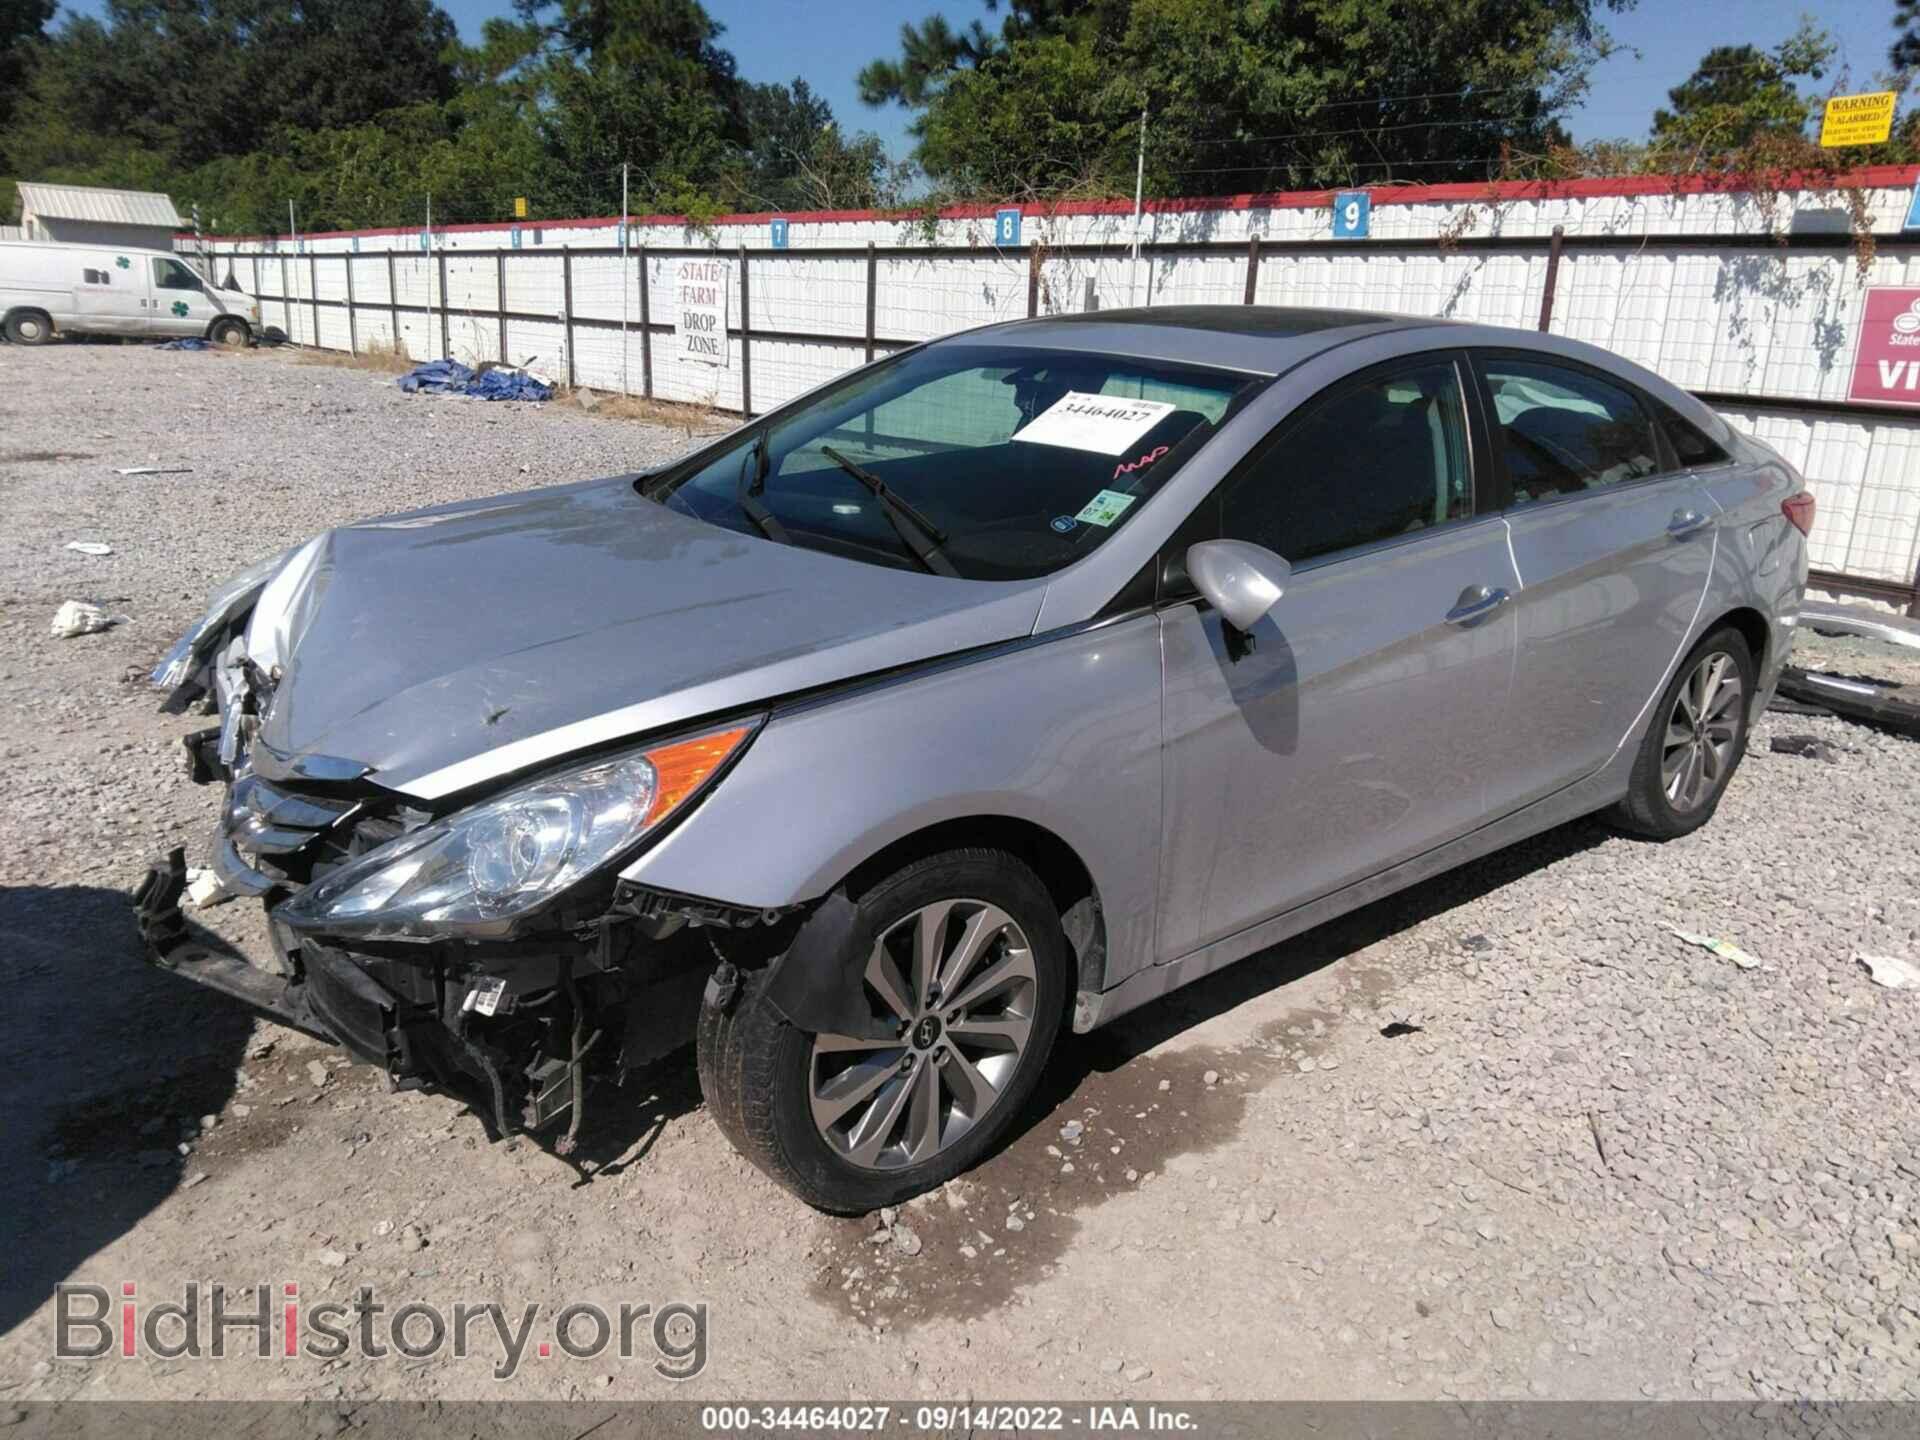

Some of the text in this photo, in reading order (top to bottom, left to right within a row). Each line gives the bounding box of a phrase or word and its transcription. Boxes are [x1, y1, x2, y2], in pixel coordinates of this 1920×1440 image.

[1831, 95, 1890, 112] WARNING
[1345, 202, 1360, 230] 9
[775, 224, 783, 244] 7
[1003, 216, 1013, 239] 8
[681, 262, 720, 282] STATE
[683, 285, 716, 305] FARM
[683, 312, 717, 332] DROP
[686, 334, 720, 356] ZONE
[1888, 333, 1920, 346] State
[1058, 402, 1152, 422] 34464027
